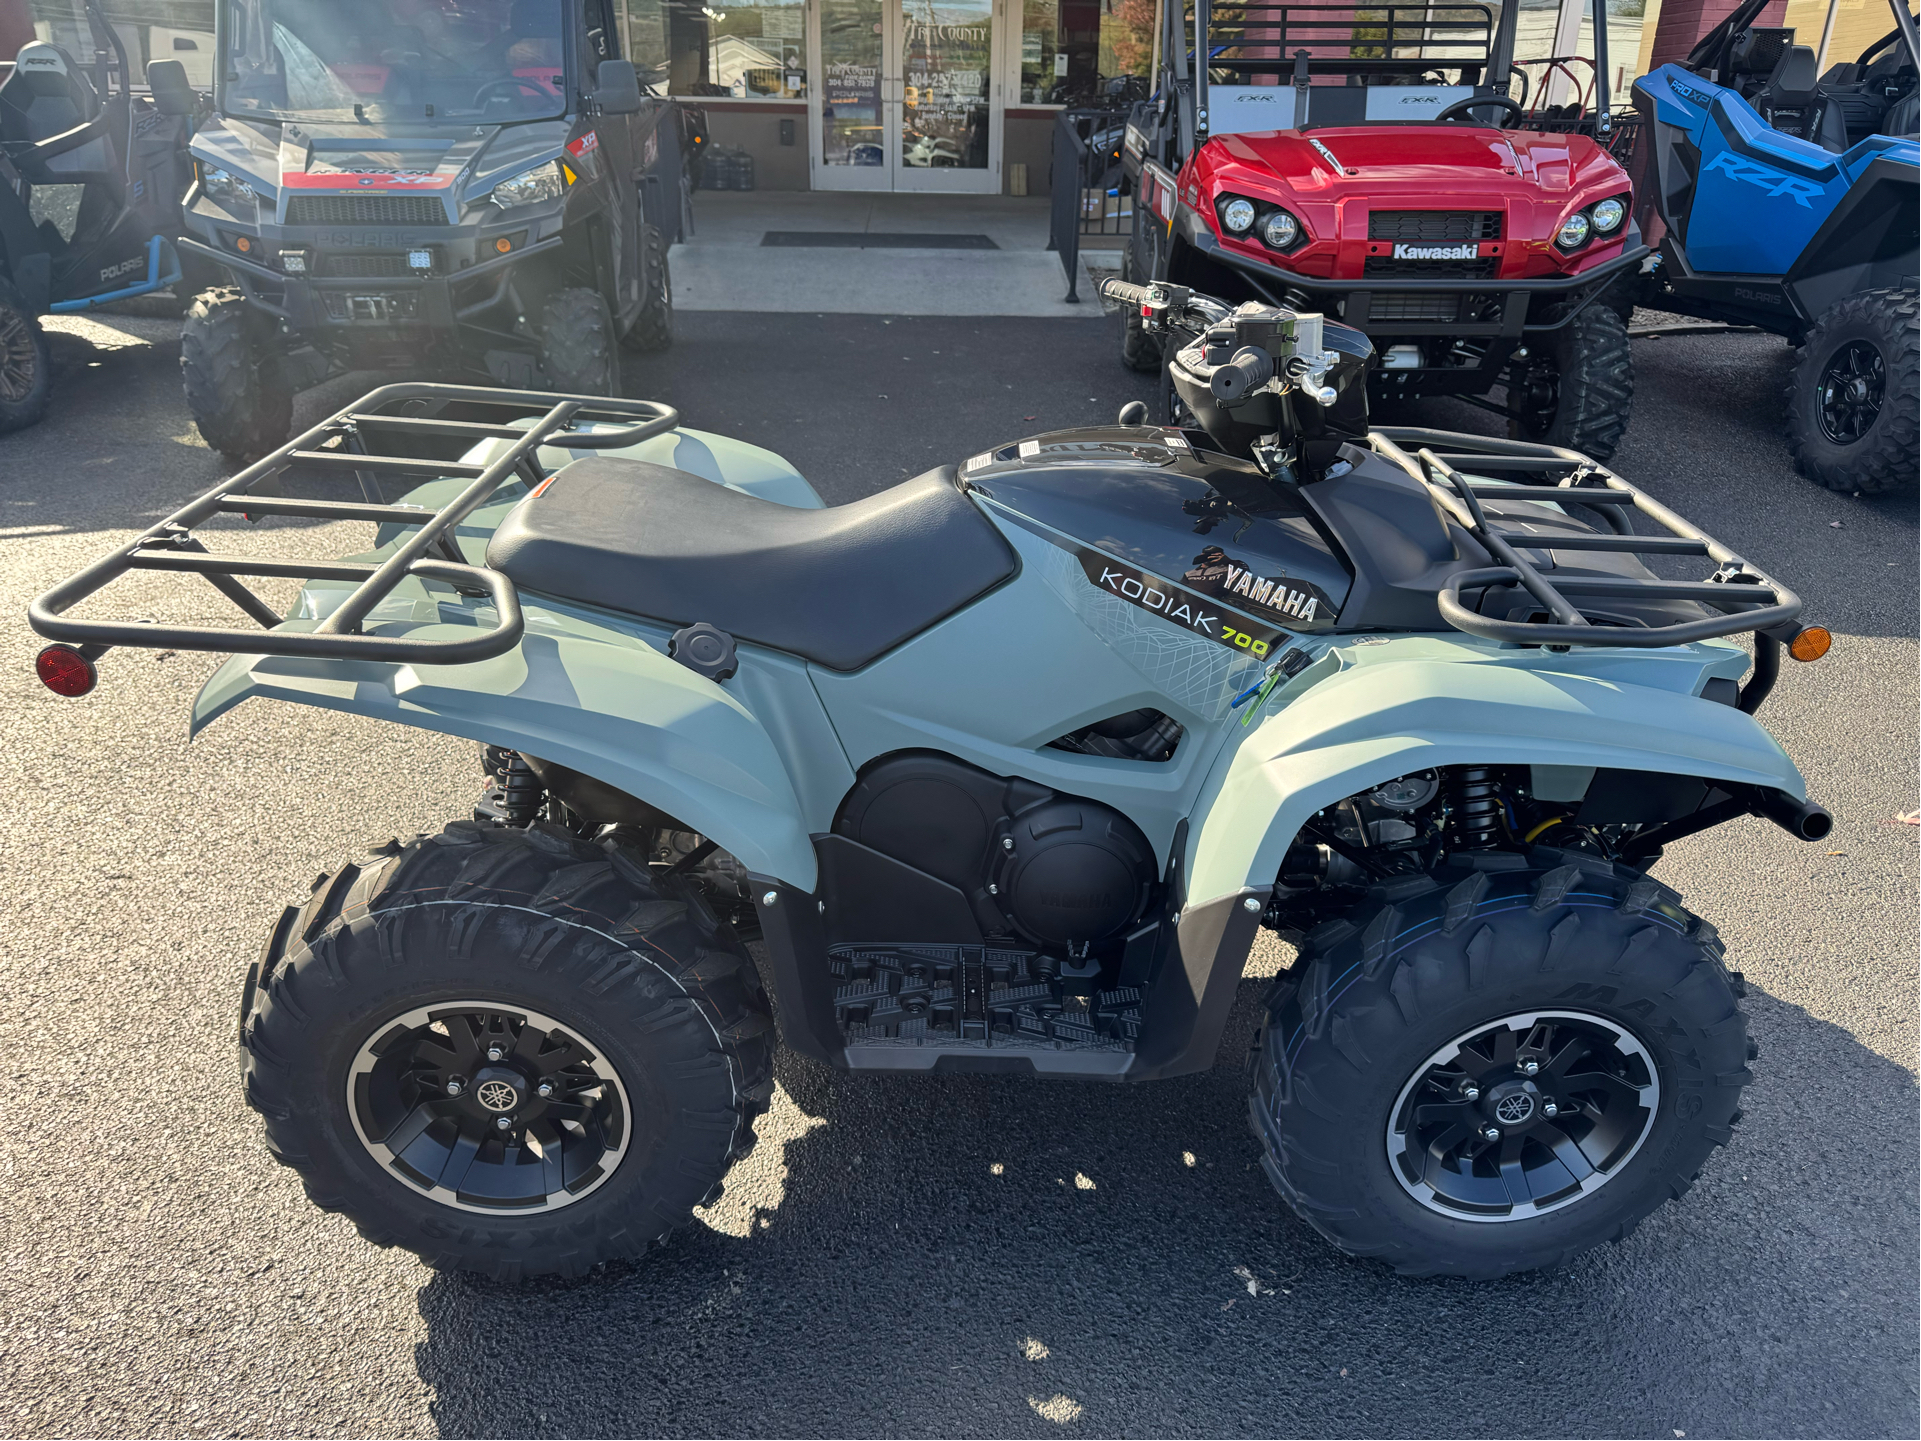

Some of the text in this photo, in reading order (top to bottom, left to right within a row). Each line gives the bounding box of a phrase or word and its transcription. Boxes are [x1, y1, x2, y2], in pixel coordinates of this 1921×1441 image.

[25, 57, 56, 66] RZR
[1670, 79, 1711, 104] PRO XP
[581, 132, 596, 149] XP
[387, 175, 444, 185] XP
[1703, 150, 1826, 210] RZR
[315, 231, 416, 247] POLARIS
[1393, 243, 1479, 260] Kawasaki
[100, 255, 144, 282] POLARIS
[1734, 287, 1782, 305] POLARIS
[1223, 563, 1319, 623] YAMAHA
[1099, 566, 1269, 655] KODIAK 700
[1552, 981, 1704, 1120] MAXXIS
